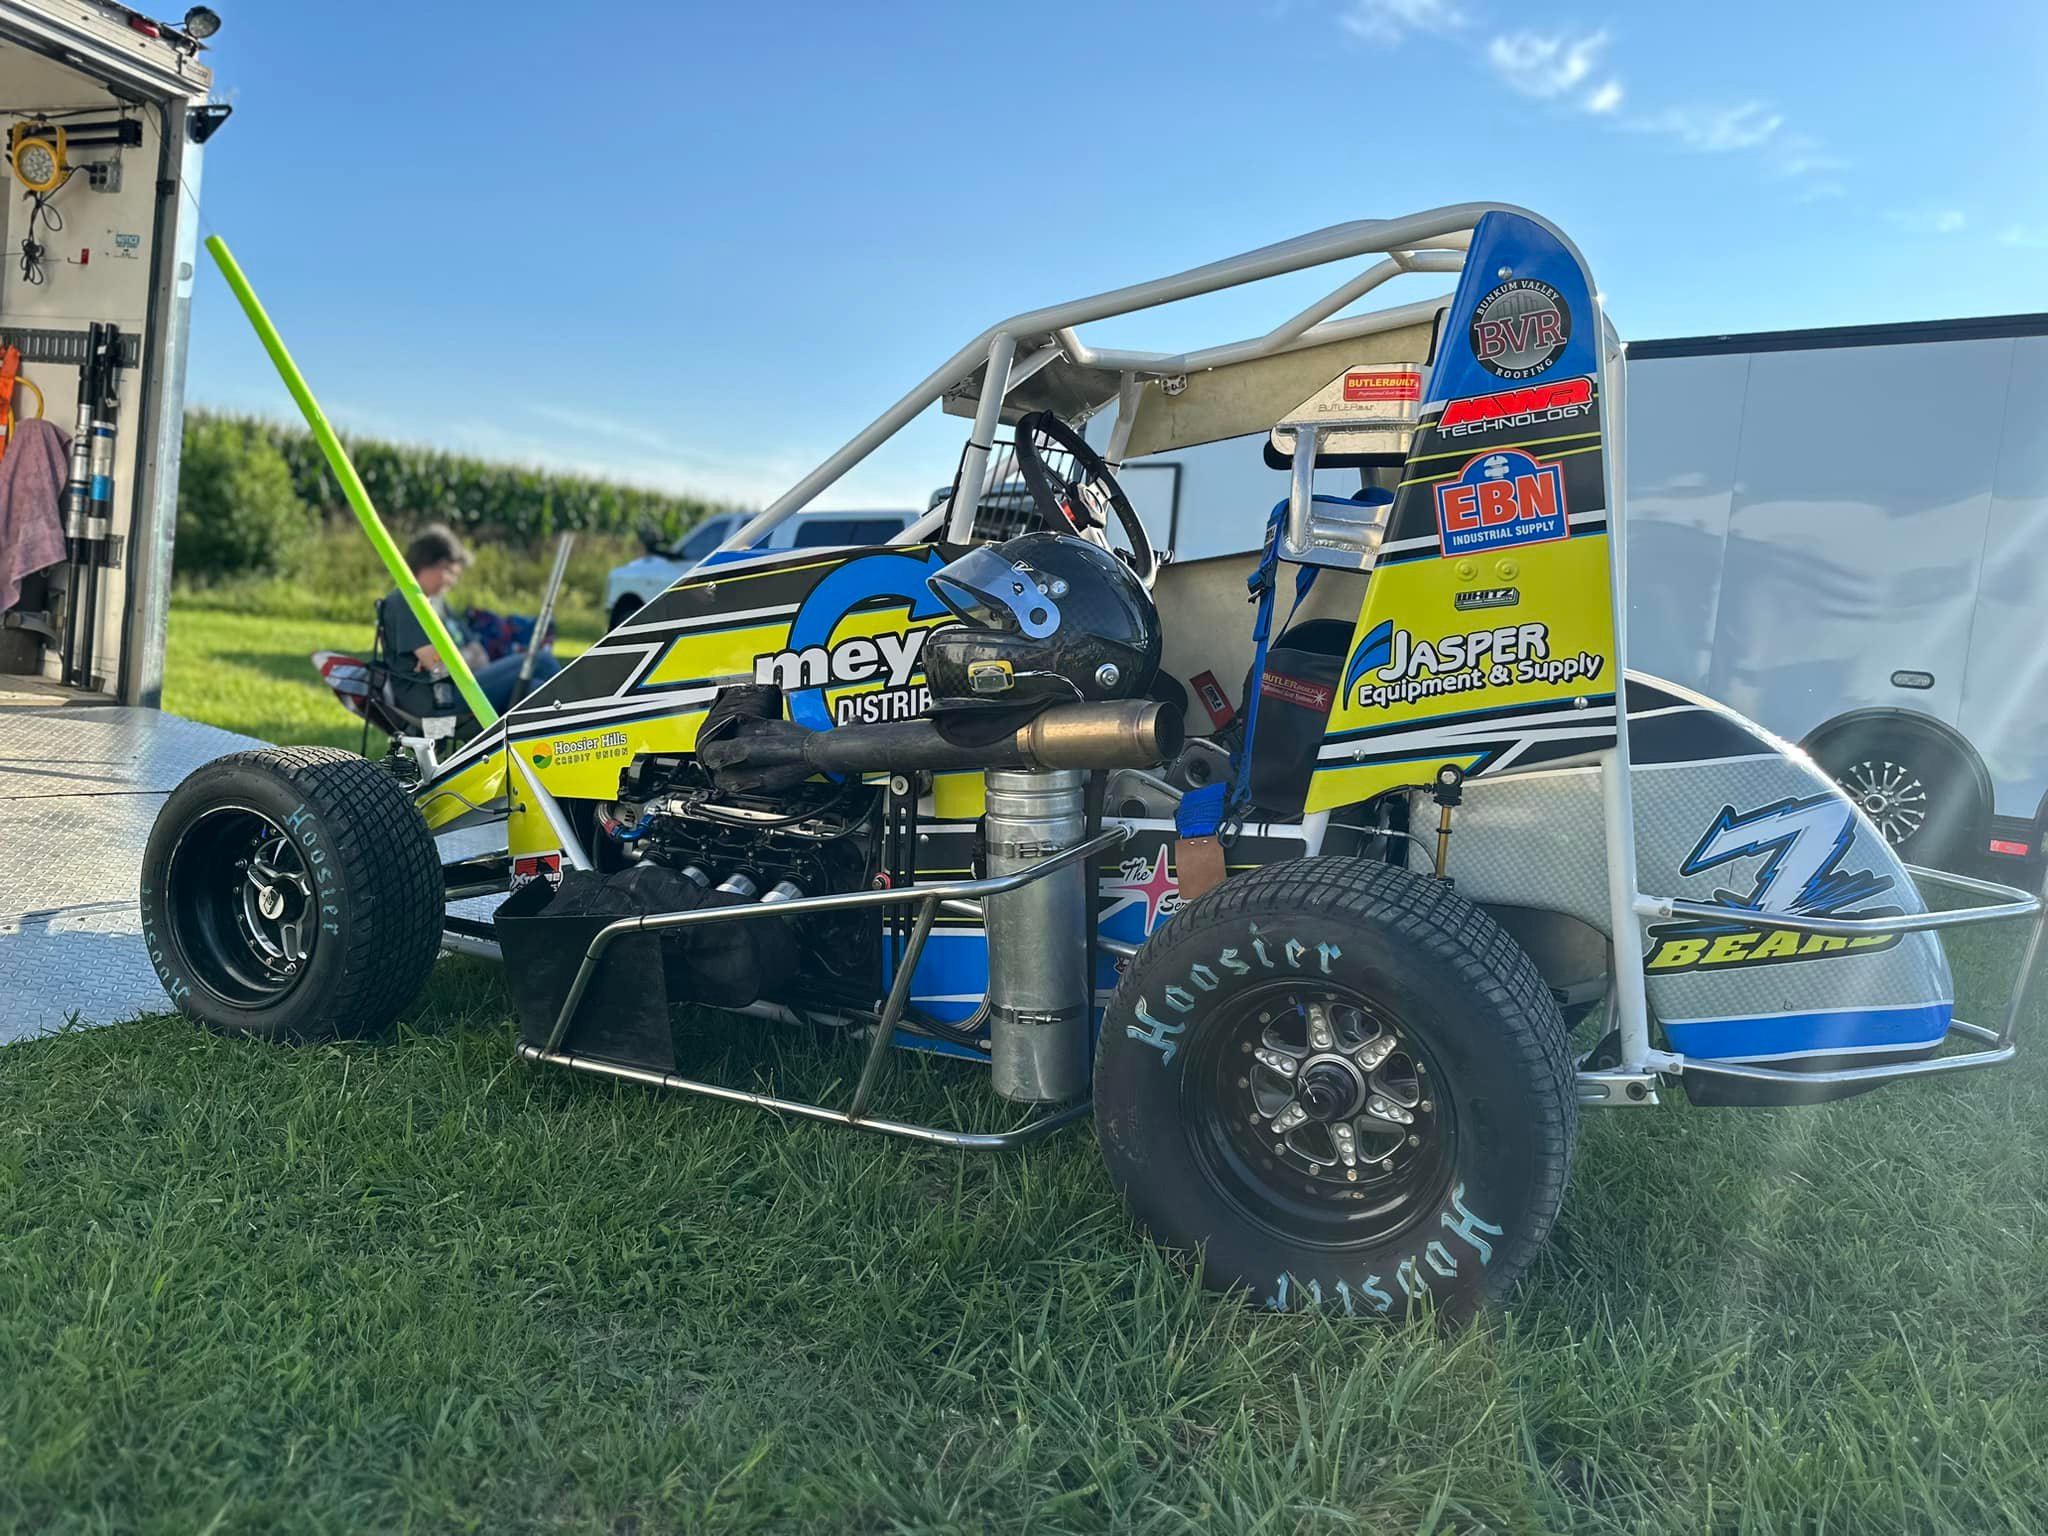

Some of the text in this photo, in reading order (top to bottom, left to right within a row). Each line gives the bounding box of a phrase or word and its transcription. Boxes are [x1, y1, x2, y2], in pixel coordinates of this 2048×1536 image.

[1476, 280, 1559, 315] BUNKUM VALLEY
[1474, 308, 1567, 360] BVR
[1495, 358, 1553, 379] ROOFING
[1436, 403, 1593, 439] TECHNOLOGY
[1440, 470, 1559, 532] EBN
[1452, 520, 1555, 546] INDUSTRIAL SUPPLY
[756, 625, 966, 690] mey
[1377, 623, 1549, 682] JASPER
[1358, 652, 1604, 709] Equipment & Supply
[554, 731, 628, 755] Hoosier Hills
[554, 747, 629, 766] CREDIT UNION
[283, 803, 342, 936] Hoosier
[1119, 856, 1153, 883] The
[1680, 796, 1860, 916] 7
[1127, 920, 1343, 1067] Hoosier
